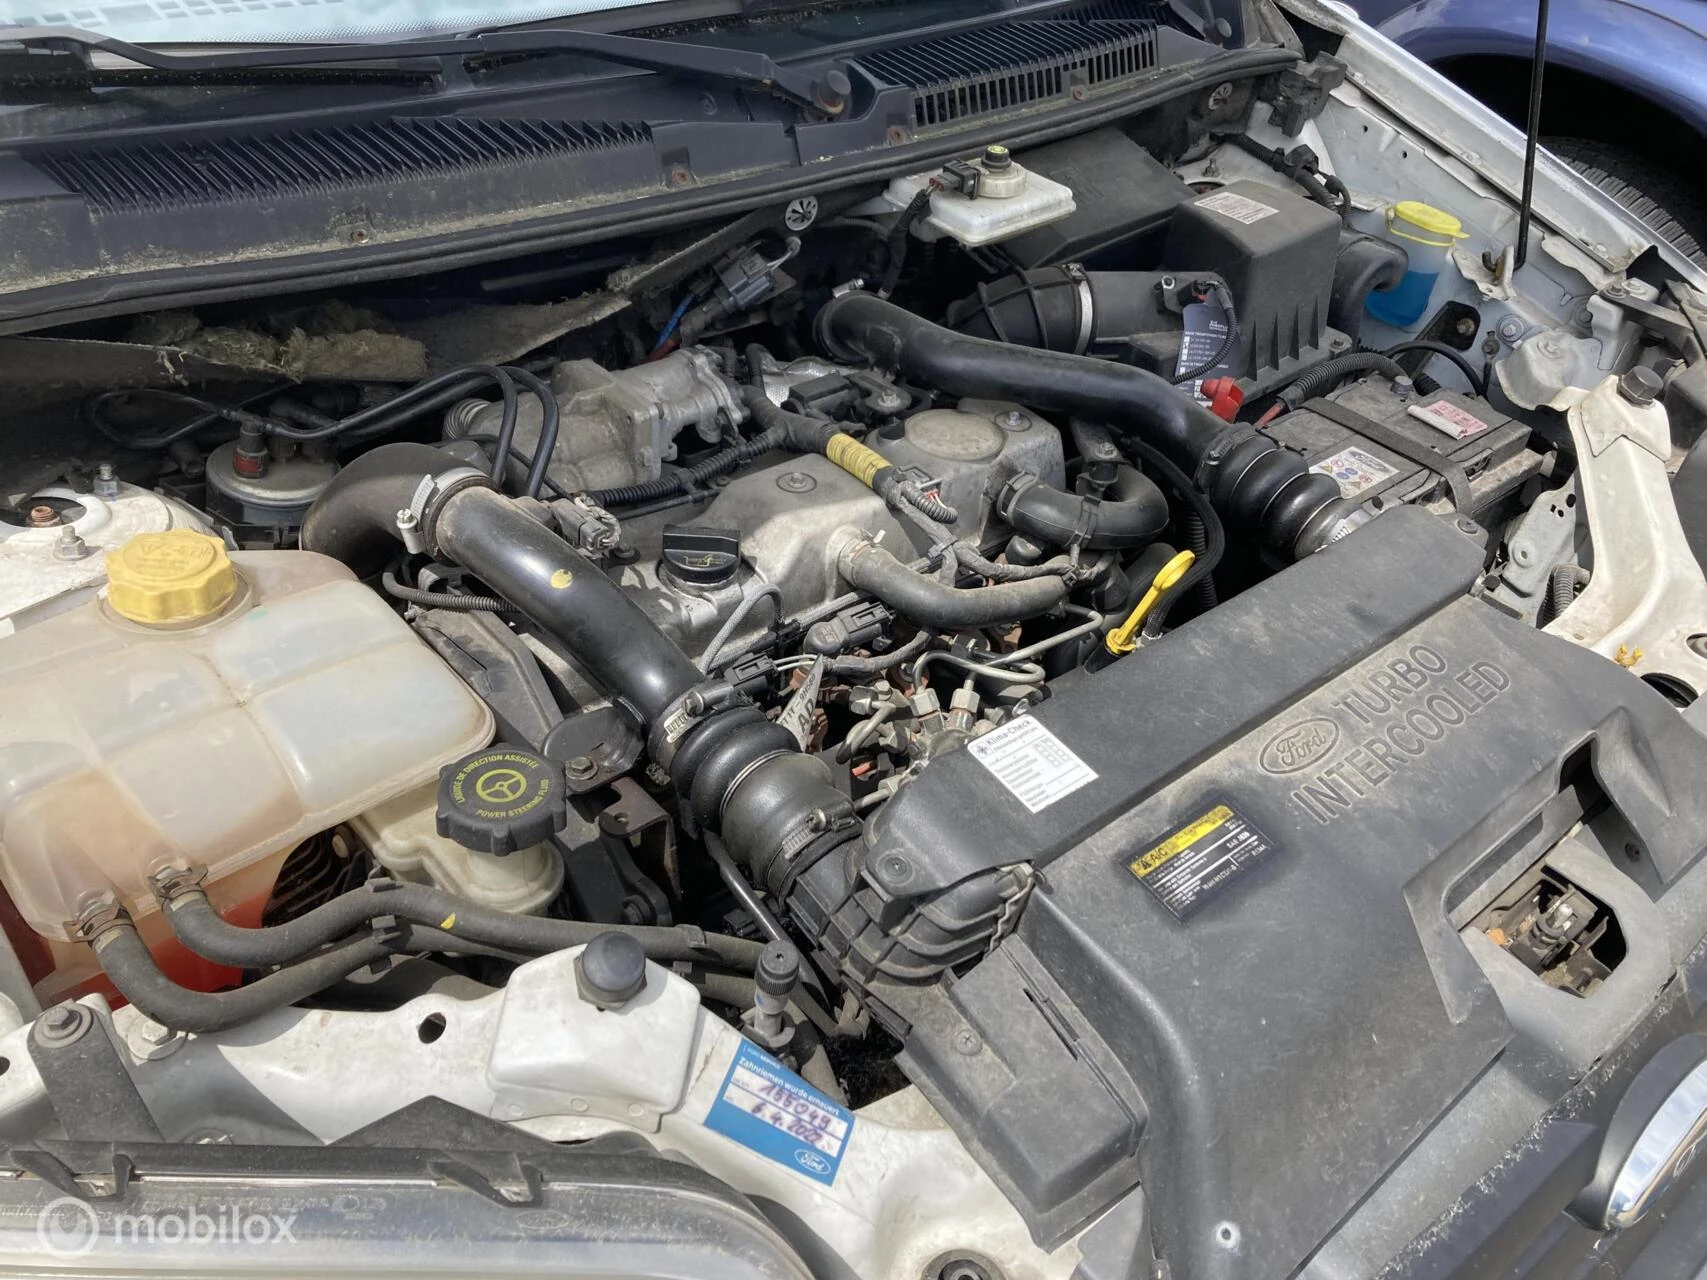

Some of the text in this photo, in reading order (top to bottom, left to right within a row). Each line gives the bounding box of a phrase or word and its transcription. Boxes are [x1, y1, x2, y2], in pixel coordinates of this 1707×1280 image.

[1331, 645, 1448, 725] TURBO
[798, 698, 814, 733] AD
[986, 719, 1032, 746] Klima-Check
[1275, 727, 1328, 767] Ford
[1290, 660, 1512, 825] INTERCOOLED
[463, 755, 503, 773] DIRECTION
[475, 809, 507, 818] POWER
[508, 796, 542, 816] STEERING
[1150, 847, 1169, 863] A/C
[738, 1056, 785, 1087] Zahnriemen
[783, 1080, 809, 1098] wurde
[807, 1093, 841, 1117] erneuert
[800, 1150, 825, 1172] Ford
